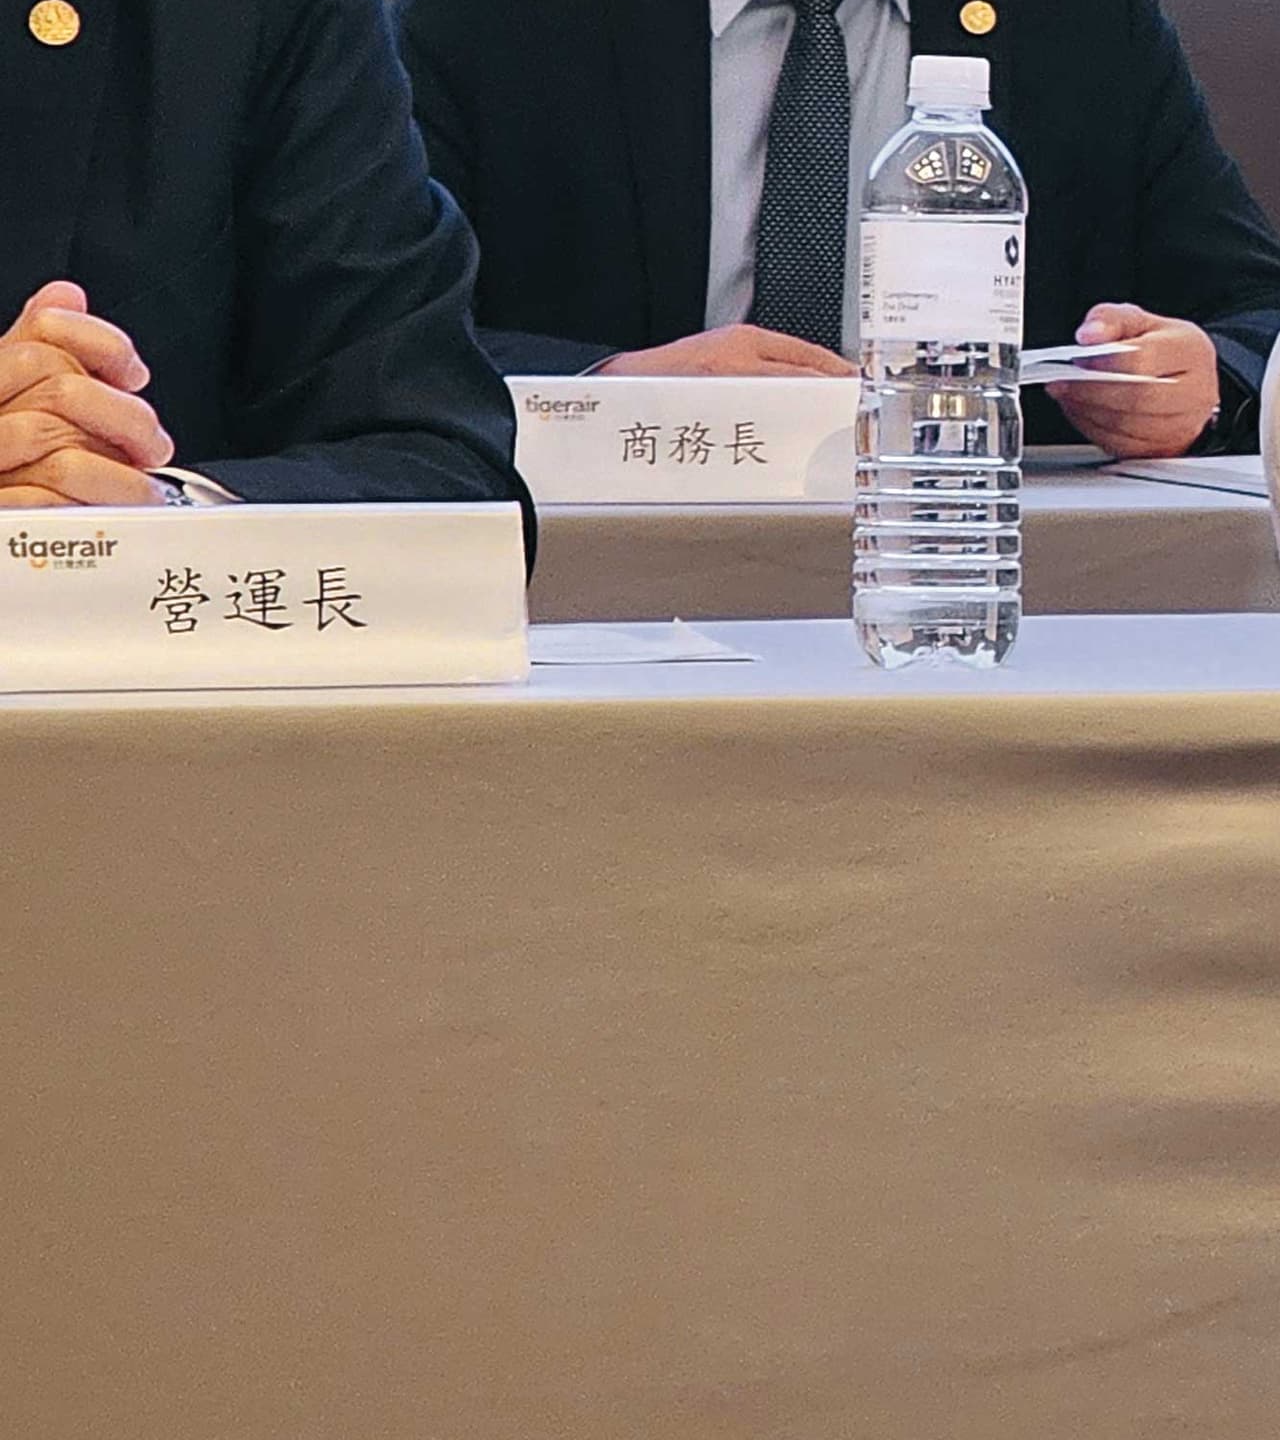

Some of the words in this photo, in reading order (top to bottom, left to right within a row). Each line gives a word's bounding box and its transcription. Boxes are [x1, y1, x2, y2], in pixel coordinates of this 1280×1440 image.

[618, 421, 769, 466] 商務長
[8, 530, 118, 569] tigerair
[149, 566, 368, 635] 營運長
